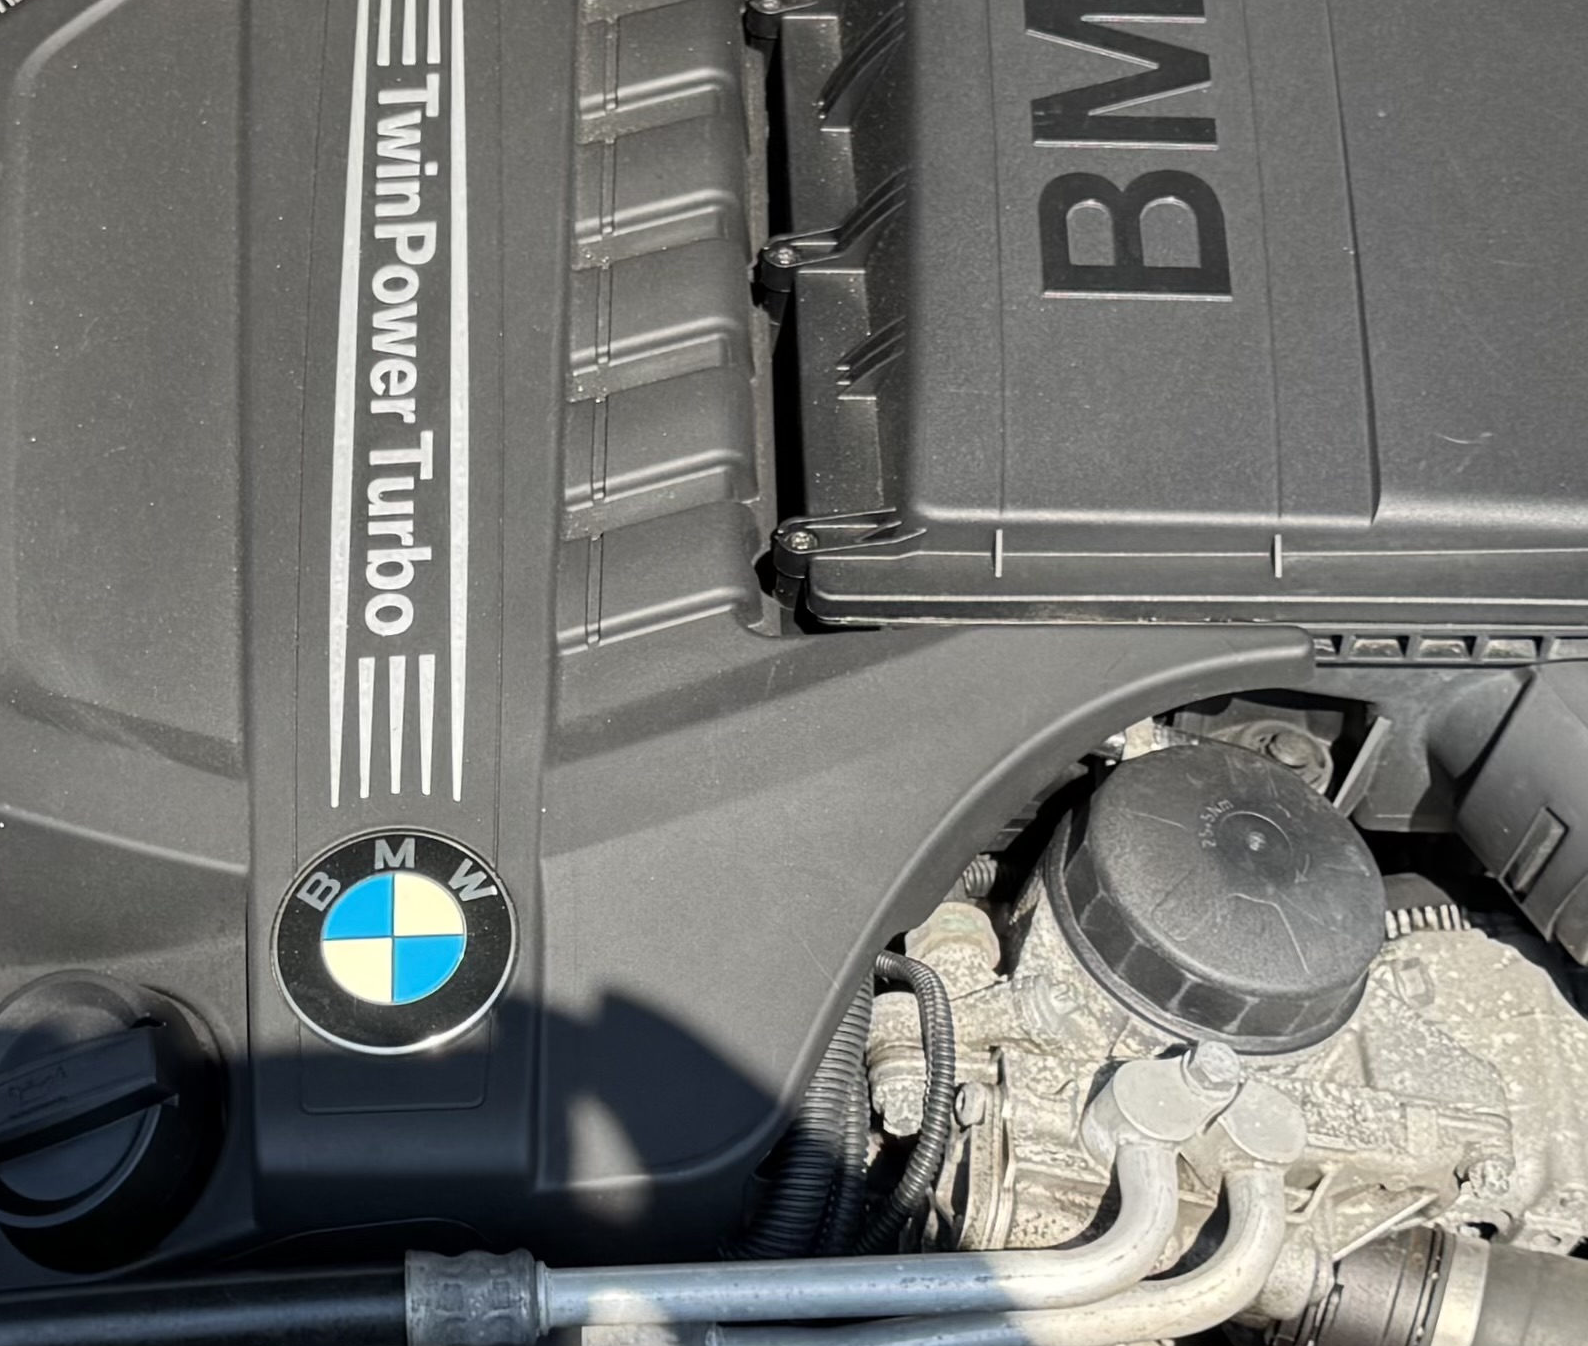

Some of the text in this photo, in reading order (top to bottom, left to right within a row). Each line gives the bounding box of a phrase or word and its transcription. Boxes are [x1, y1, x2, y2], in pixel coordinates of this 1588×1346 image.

[362, 73, 441, 636] TwinPower Turbo
[296, 838, 498, 912] BMW
